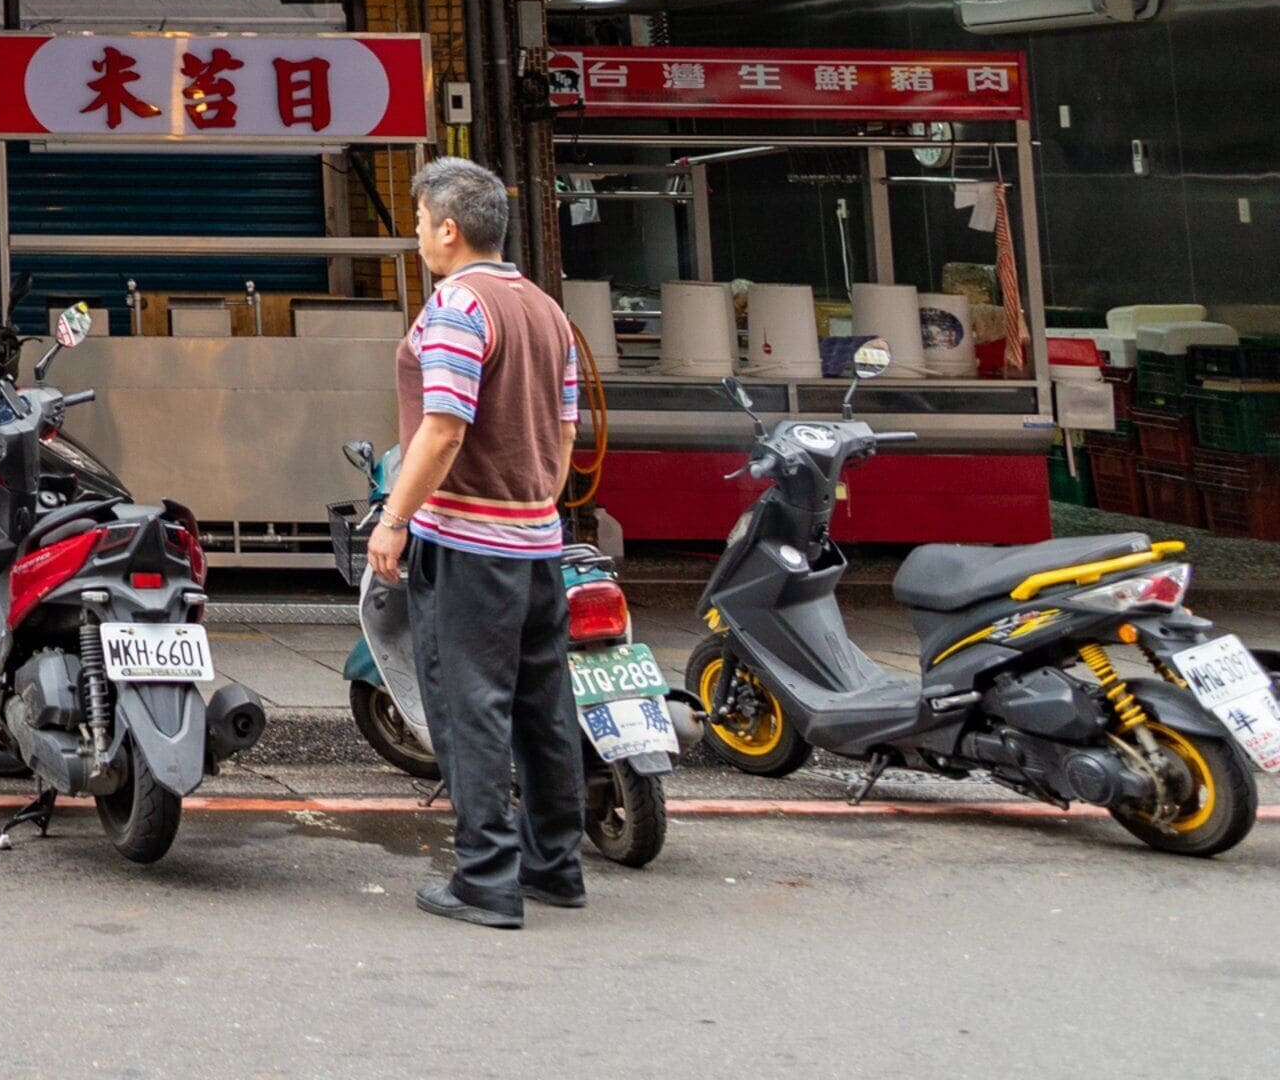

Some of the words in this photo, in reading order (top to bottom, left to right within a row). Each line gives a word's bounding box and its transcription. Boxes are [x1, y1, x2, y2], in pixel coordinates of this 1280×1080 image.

[587, 61, 1011, 93] 台灣生鮮豬肉
